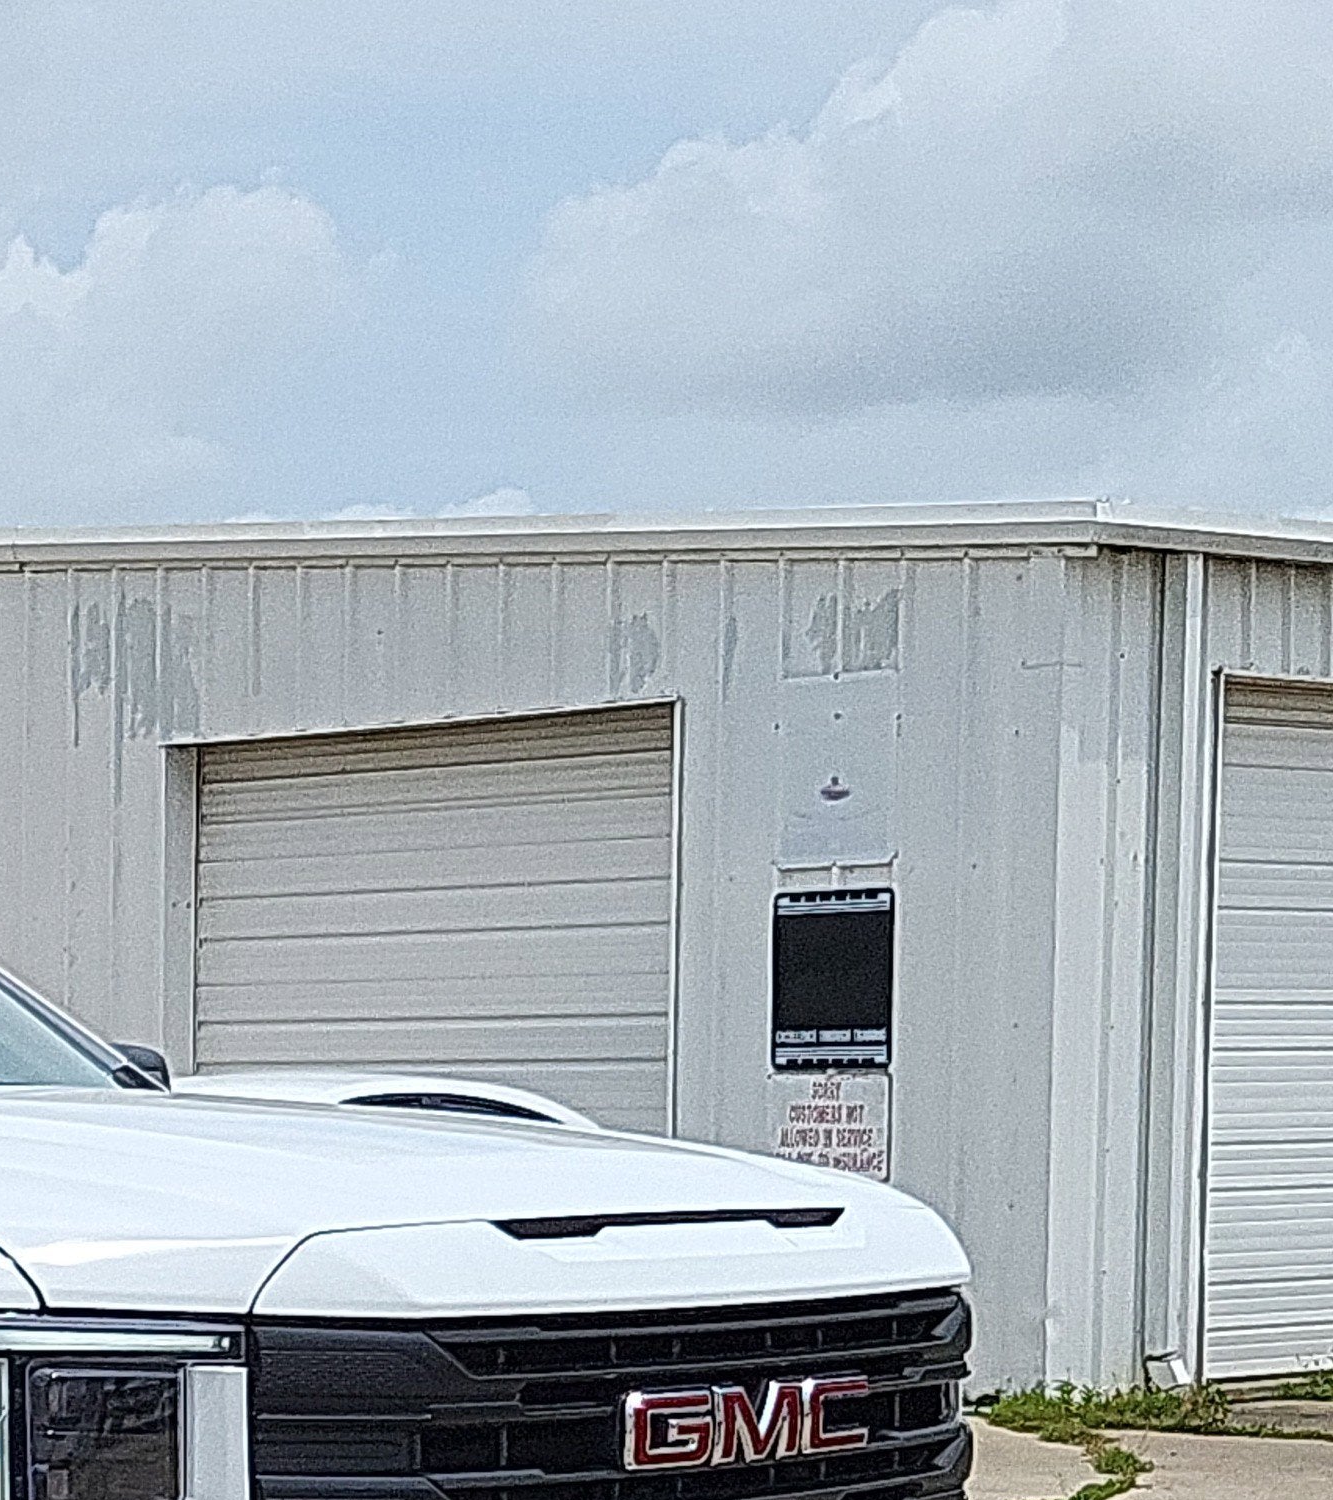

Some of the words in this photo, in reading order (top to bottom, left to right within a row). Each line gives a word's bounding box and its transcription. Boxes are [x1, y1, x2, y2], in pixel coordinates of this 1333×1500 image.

[811, 1081, 842, 1101] SORRY
[789, 1104, 842, 1125] CUSTOMERS
[846, 1104, 865, 1124] NOT
[778, 1127, 820, 1148] ALLOWED
[822, 1127, 833, 1148] IN
[836, 1127, 874, 1148] SERVICE
[623, 1374, 870, 1471] GMC
